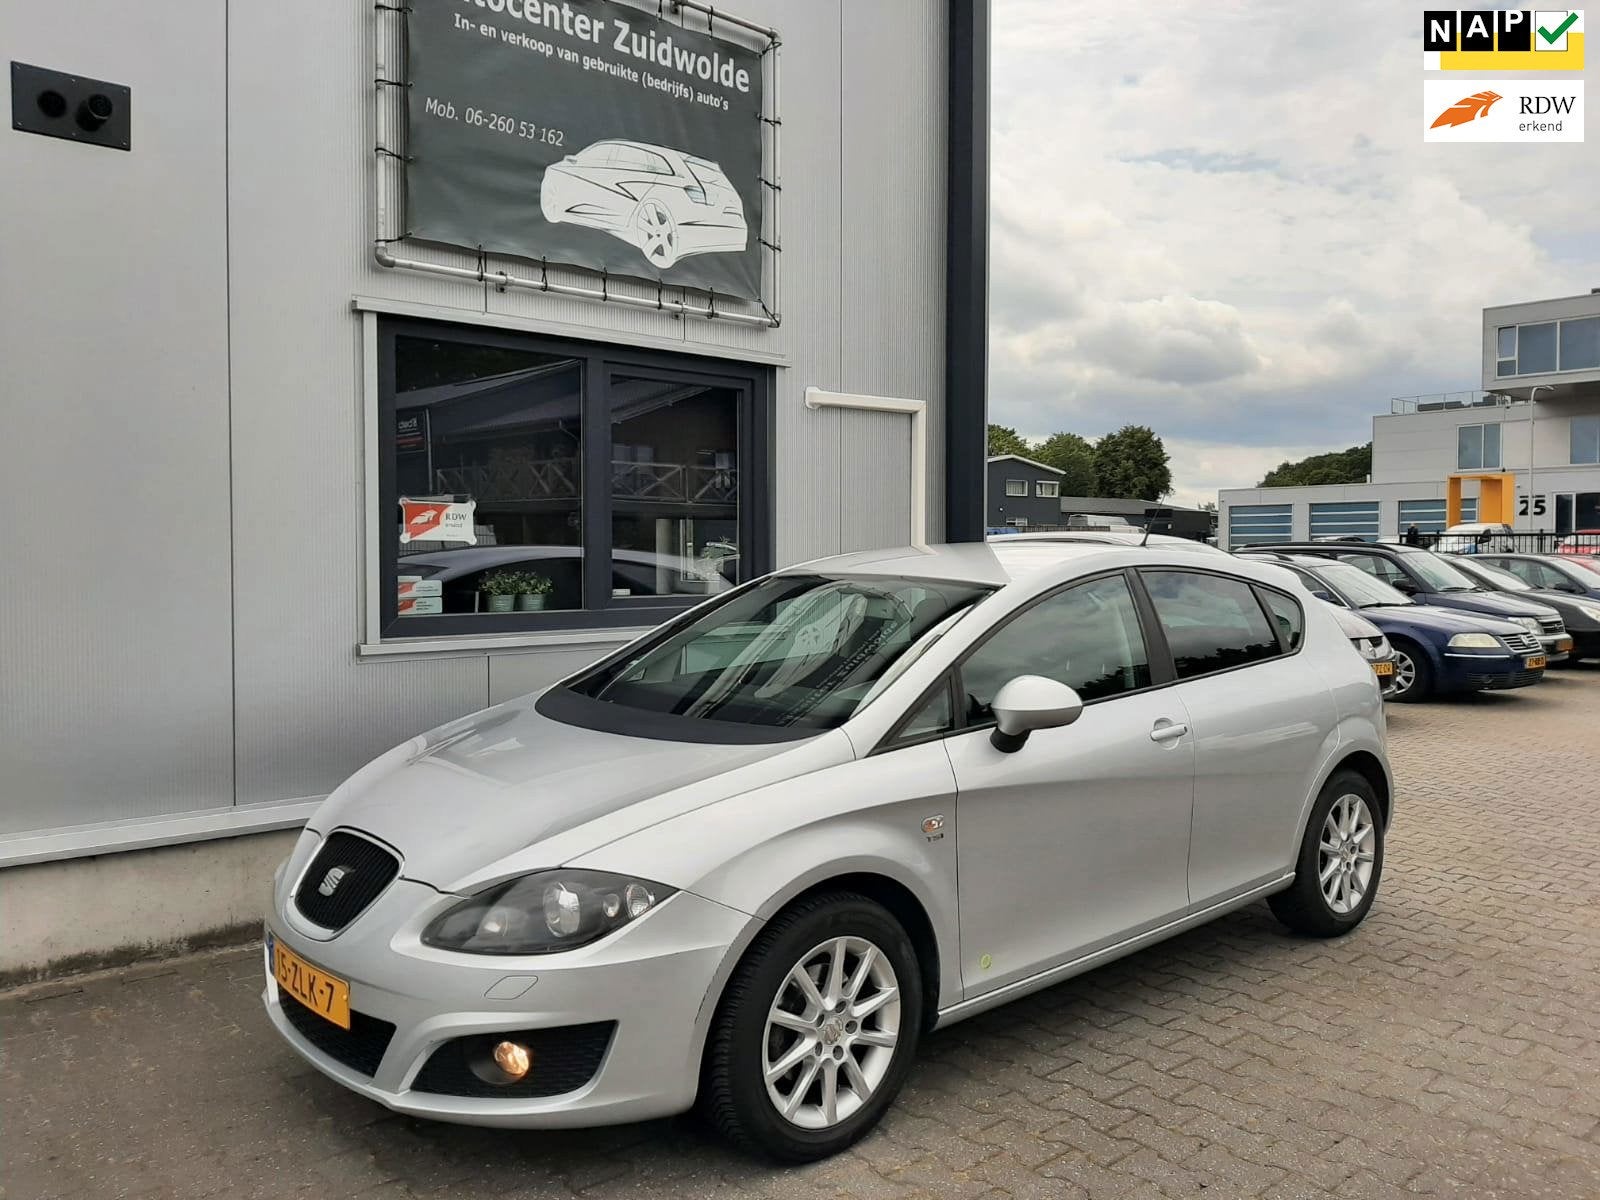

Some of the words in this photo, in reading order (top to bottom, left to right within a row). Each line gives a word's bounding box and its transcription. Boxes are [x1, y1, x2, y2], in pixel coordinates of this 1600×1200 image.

[454, 13, 476, 29] In-
[480, 24, 497, 39] en
[501, 30, 553, 57] verkoop
[557, 47, 580, 63] van
[583, 56, 639, 83] gebruikte
[642, 71, 694, 103] (bedrijfs)
[697, 92, 729, 111] auto's
[613, 19, 750, 93] Zuidwolde
[425, 97, 459, 121] Mob.
[465, 107, 515, 136] 06-260
[518, 121, 536, 140] 53
[540, 127, 565, 147] 162
[445, 512, 467, 521] RDW
[1518, 498, 1546, 516] 25
